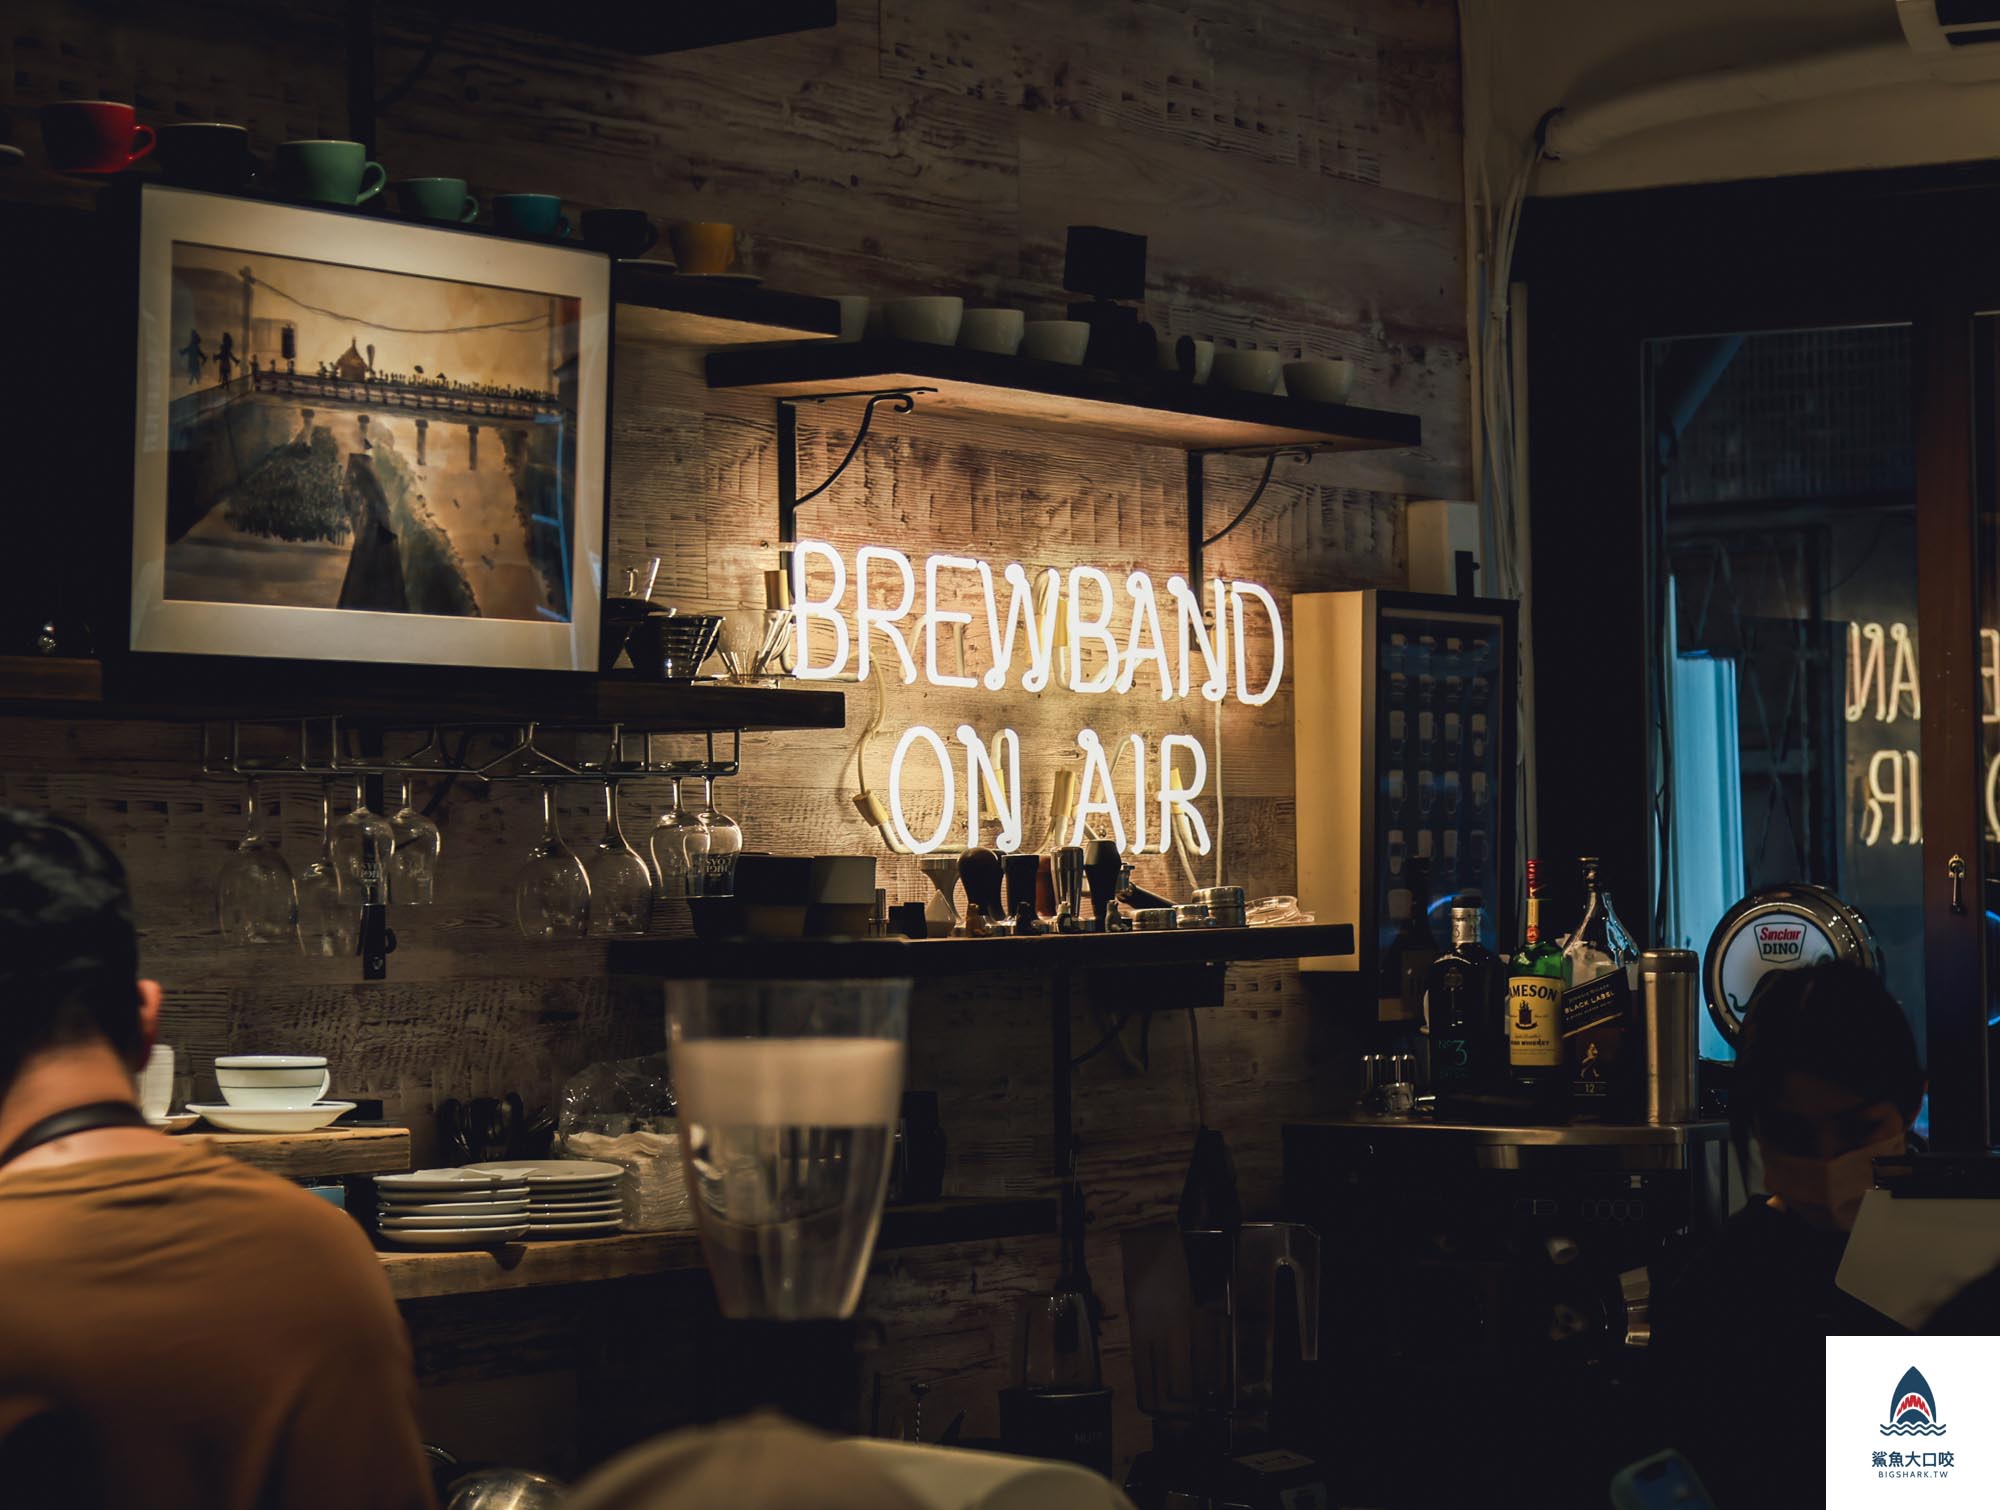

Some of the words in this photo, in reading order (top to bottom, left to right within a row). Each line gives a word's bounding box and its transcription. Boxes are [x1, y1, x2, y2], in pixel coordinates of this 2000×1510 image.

[793, 540, 1285, 706] BREWBAND
[889, 724, 1022, 855] ON
[1070, 728, 1211, 856] AIR
[1760, 927, 1802, 942] Sinclair
[1763, 943, 1799, 955] DINO
[1564, 1000, 1590, 1015] BLACK
[1585, 1083, 1595, 1094] 12
